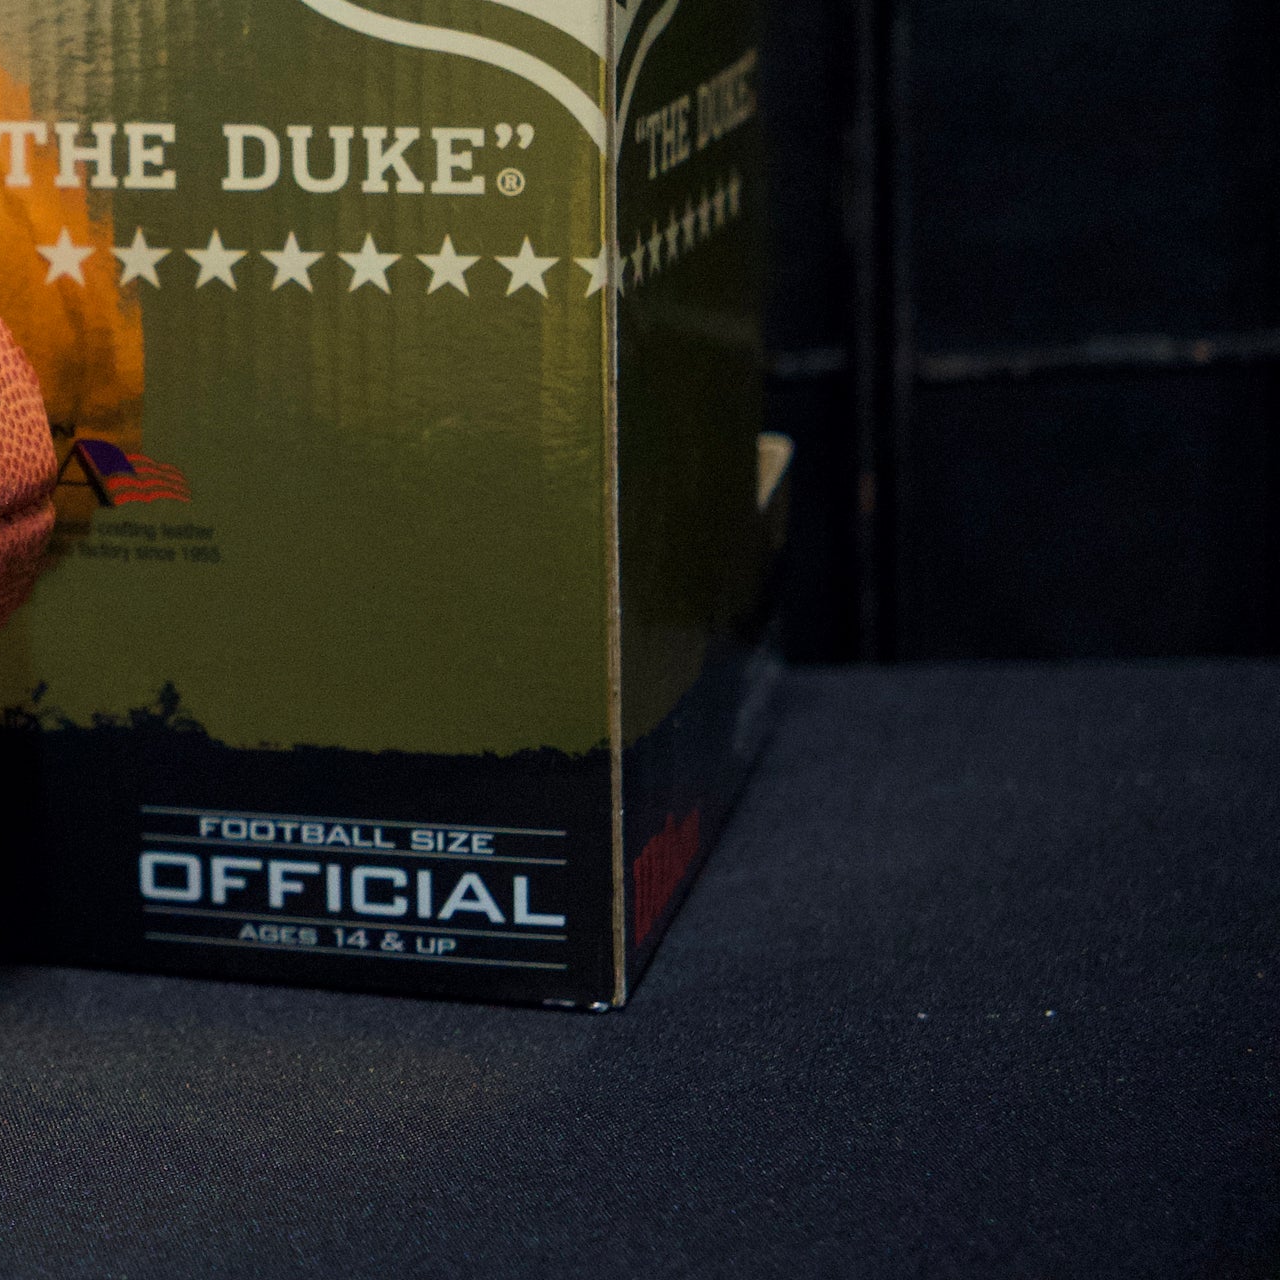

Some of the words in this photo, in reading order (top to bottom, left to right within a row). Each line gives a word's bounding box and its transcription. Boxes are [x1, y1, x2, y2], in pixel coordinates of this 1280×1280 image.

[199, 815, 397, 850] FOOTBALL
[410, 828, 496, 856] SIZE
[140, 851, 567, 928] OFFICIAL
[239, 923, 319, 947] AGES
[334, 927, 371, 949] 14
[380, 930, 408, 953] &
[415, 936, 458, 957] UP
